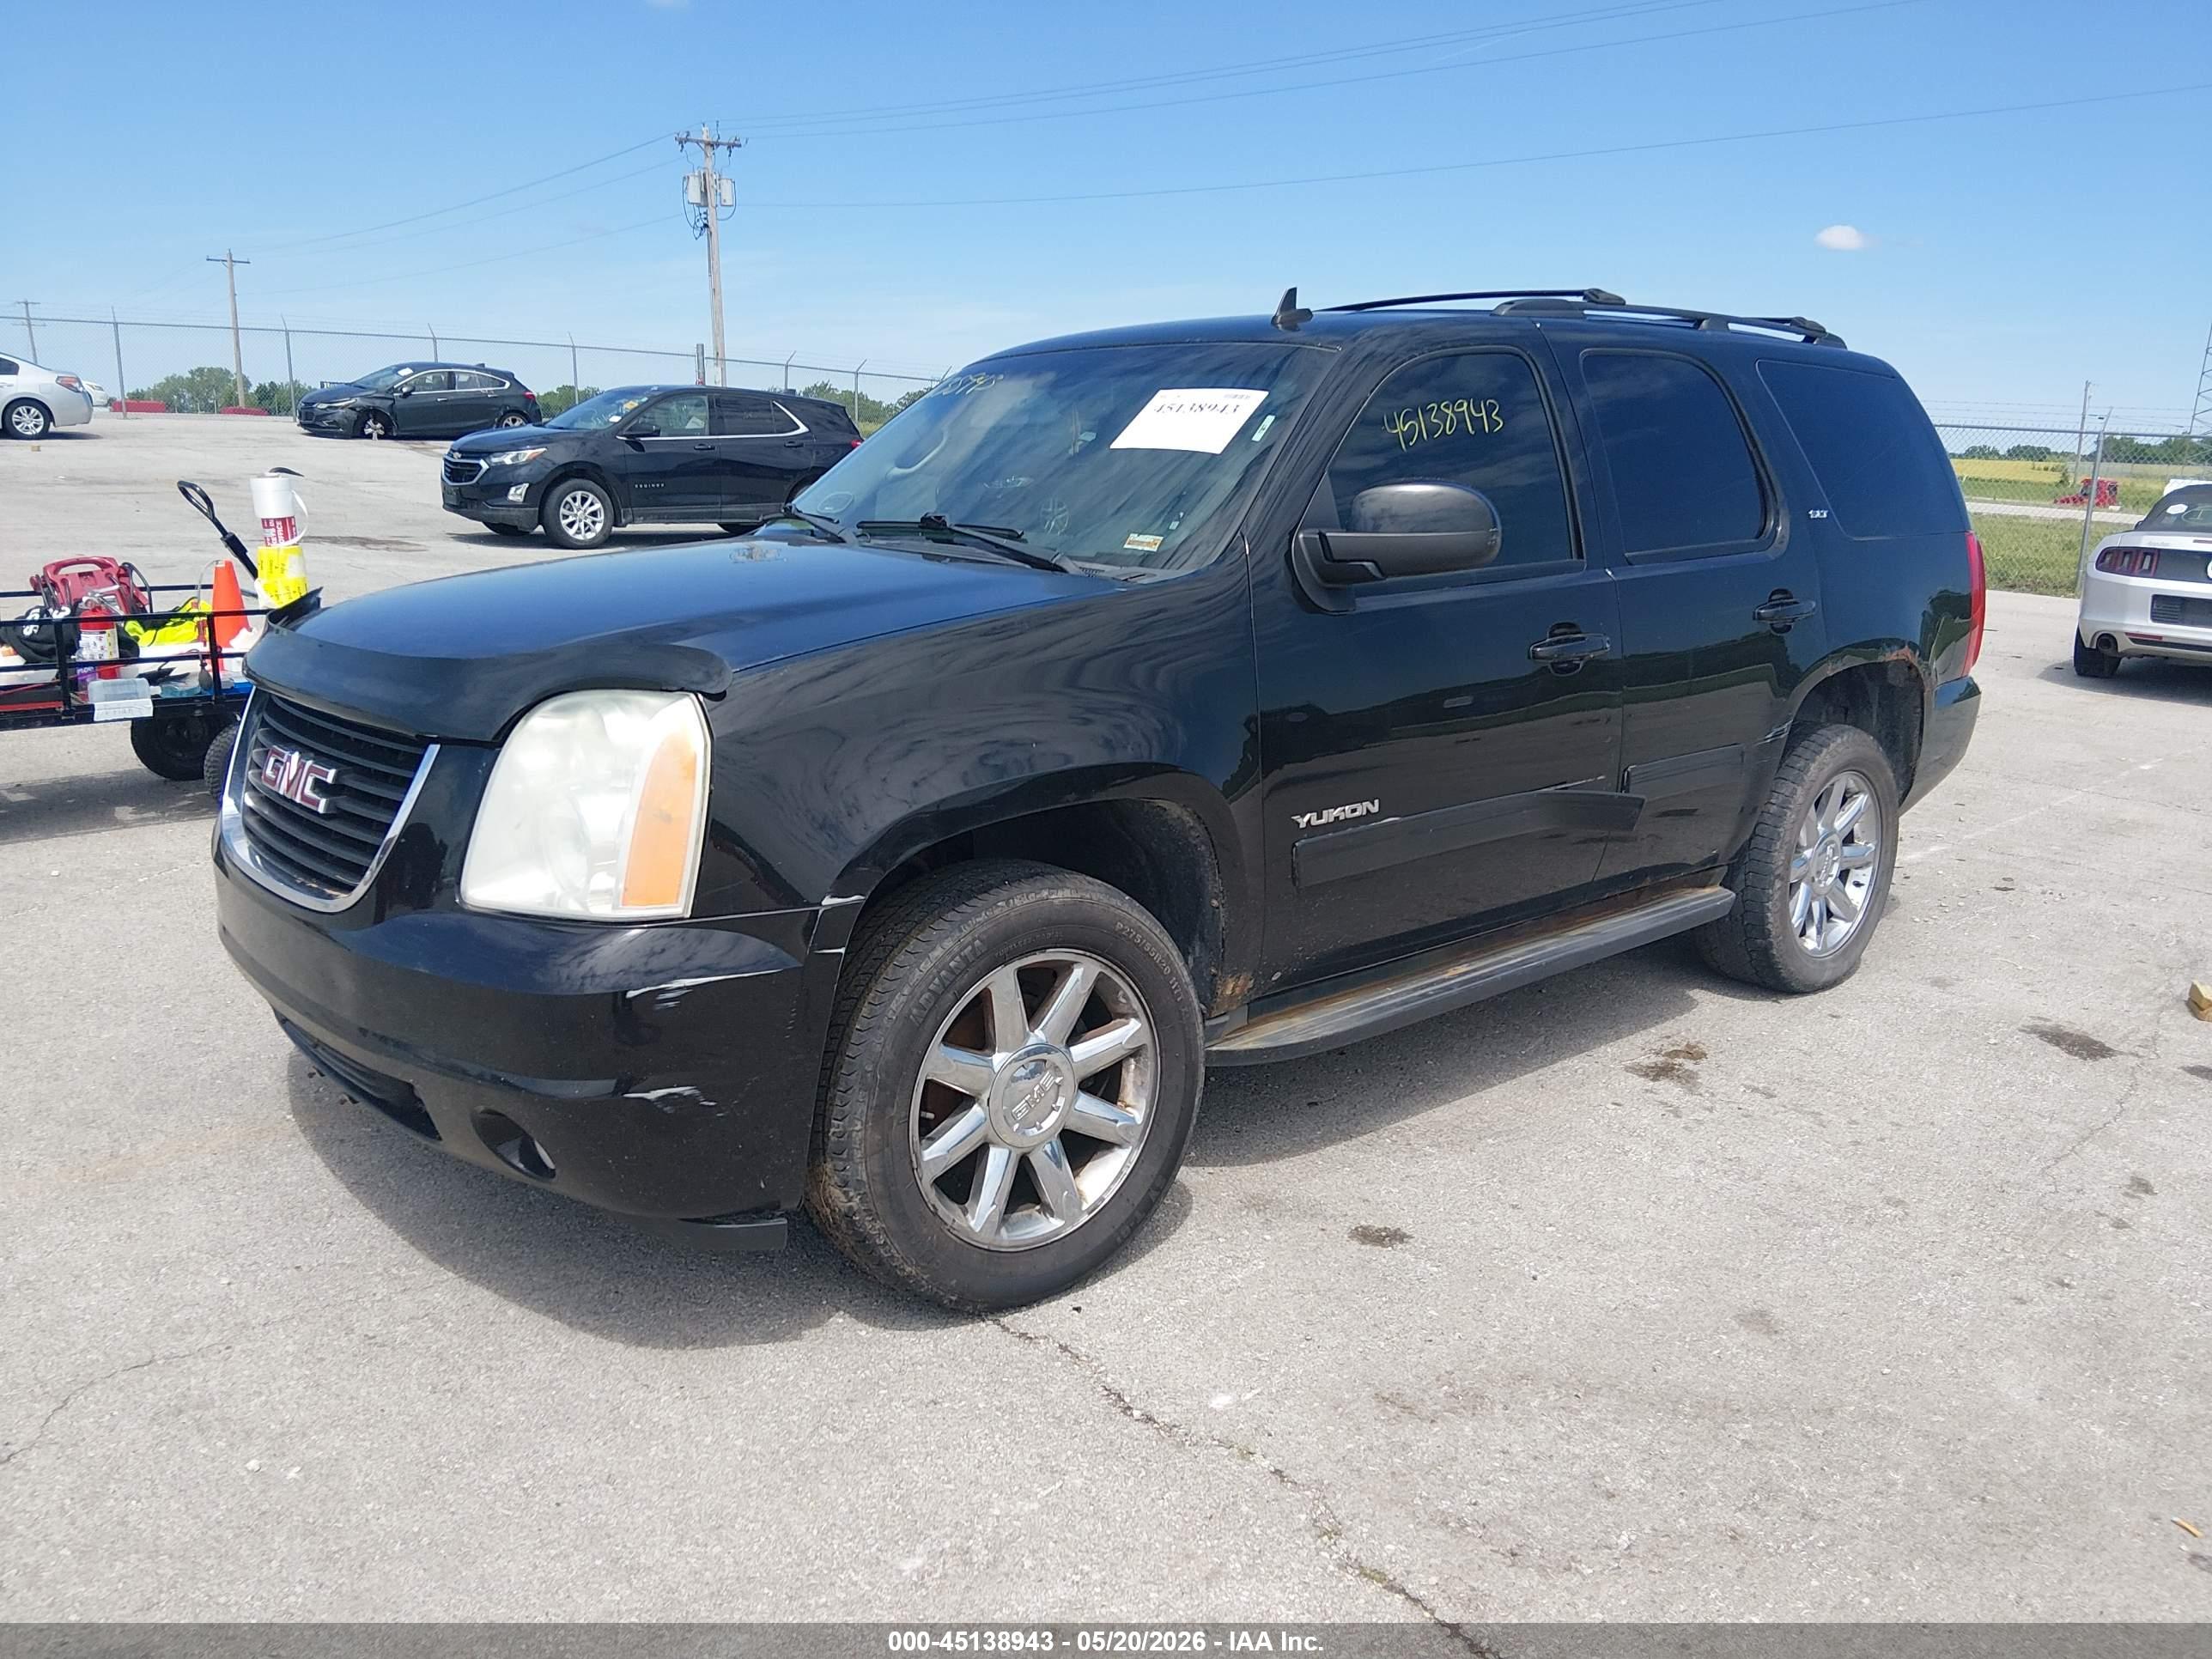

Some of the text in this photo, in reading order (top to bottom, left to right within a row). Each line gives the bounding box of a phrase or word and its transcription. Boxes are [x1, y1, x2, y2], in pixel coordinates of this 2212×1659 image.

[1382, 398, 1504, 453] 45138943
[261, 744, 337, 814] GMC
[1291, 799, 1380, 830] YUKON
[909, 939, 988, 1027] ADVANTA
